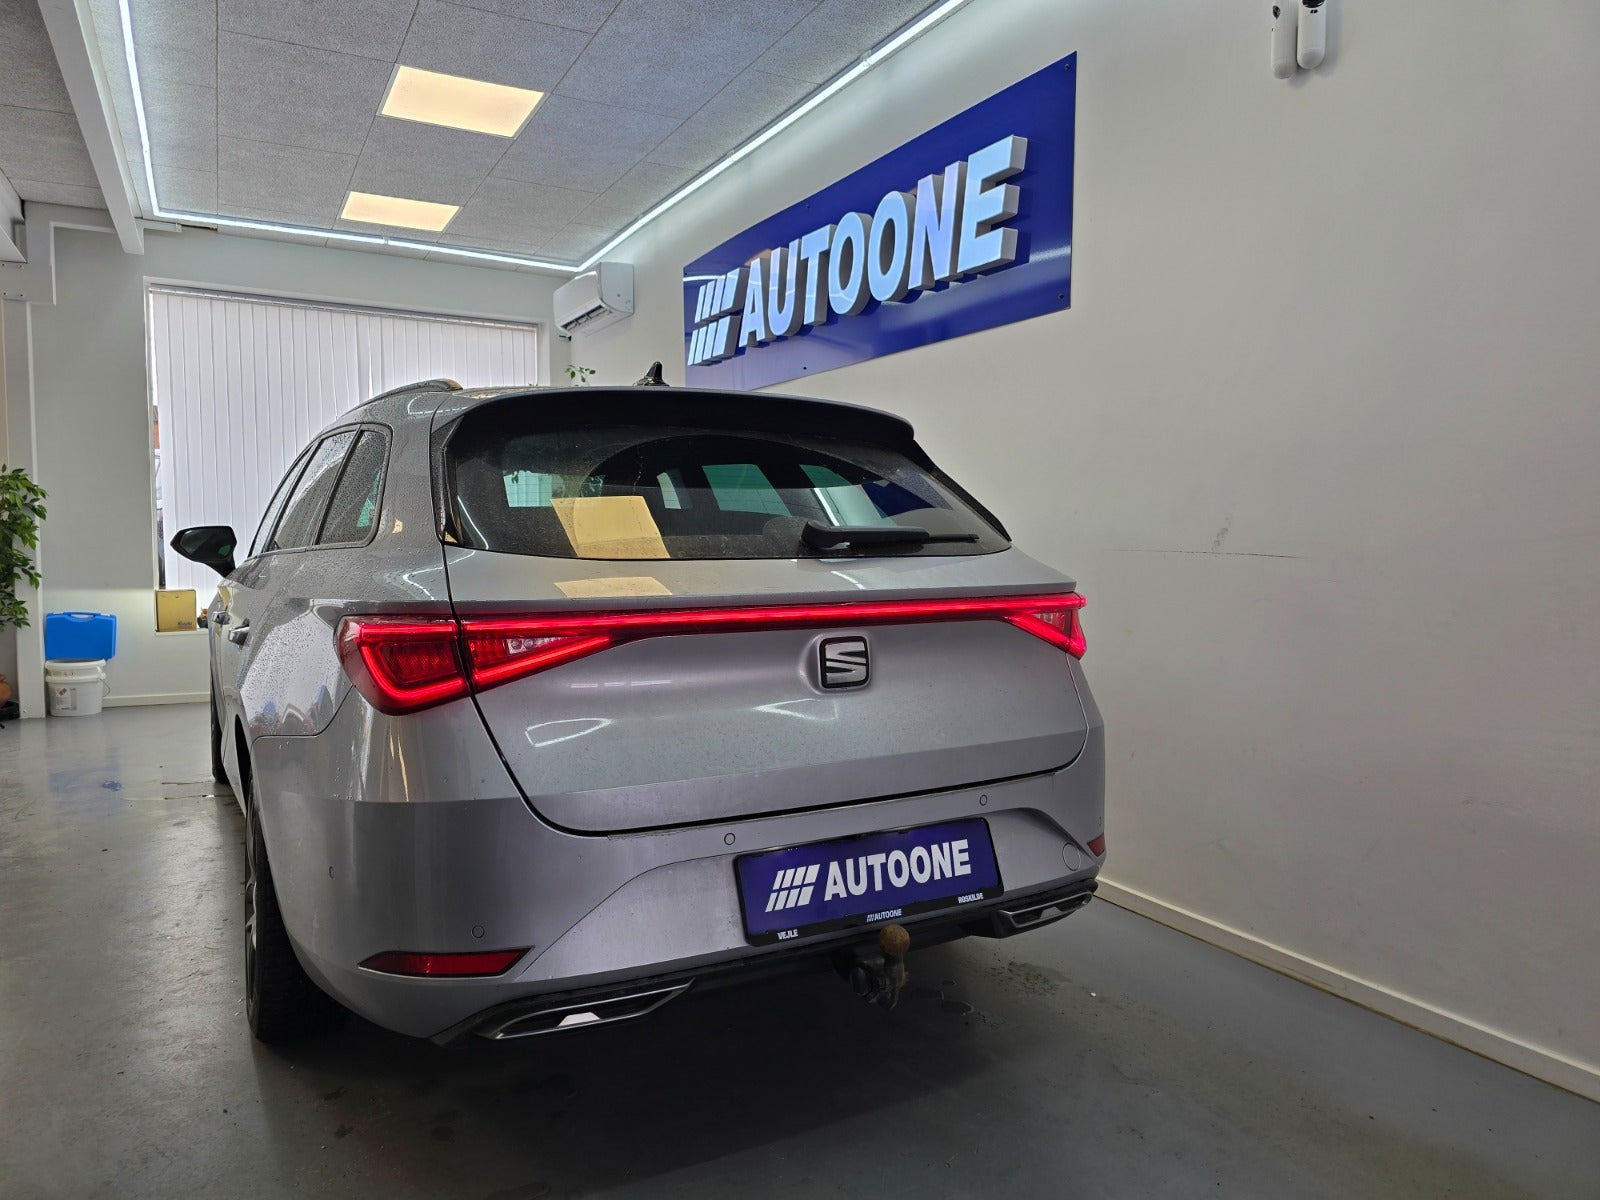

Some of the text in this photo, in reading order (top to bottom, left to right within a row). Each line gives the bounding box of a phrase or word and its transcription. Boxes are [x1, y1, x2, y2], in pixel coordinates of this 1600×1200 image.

[739, 134, 1028, 348] AUTOONE
[824, 838, 972, 901] AUTOONE
[874, 908, 902, 921] AUTOONE
[777, 929, 799, 940] VEJLE
